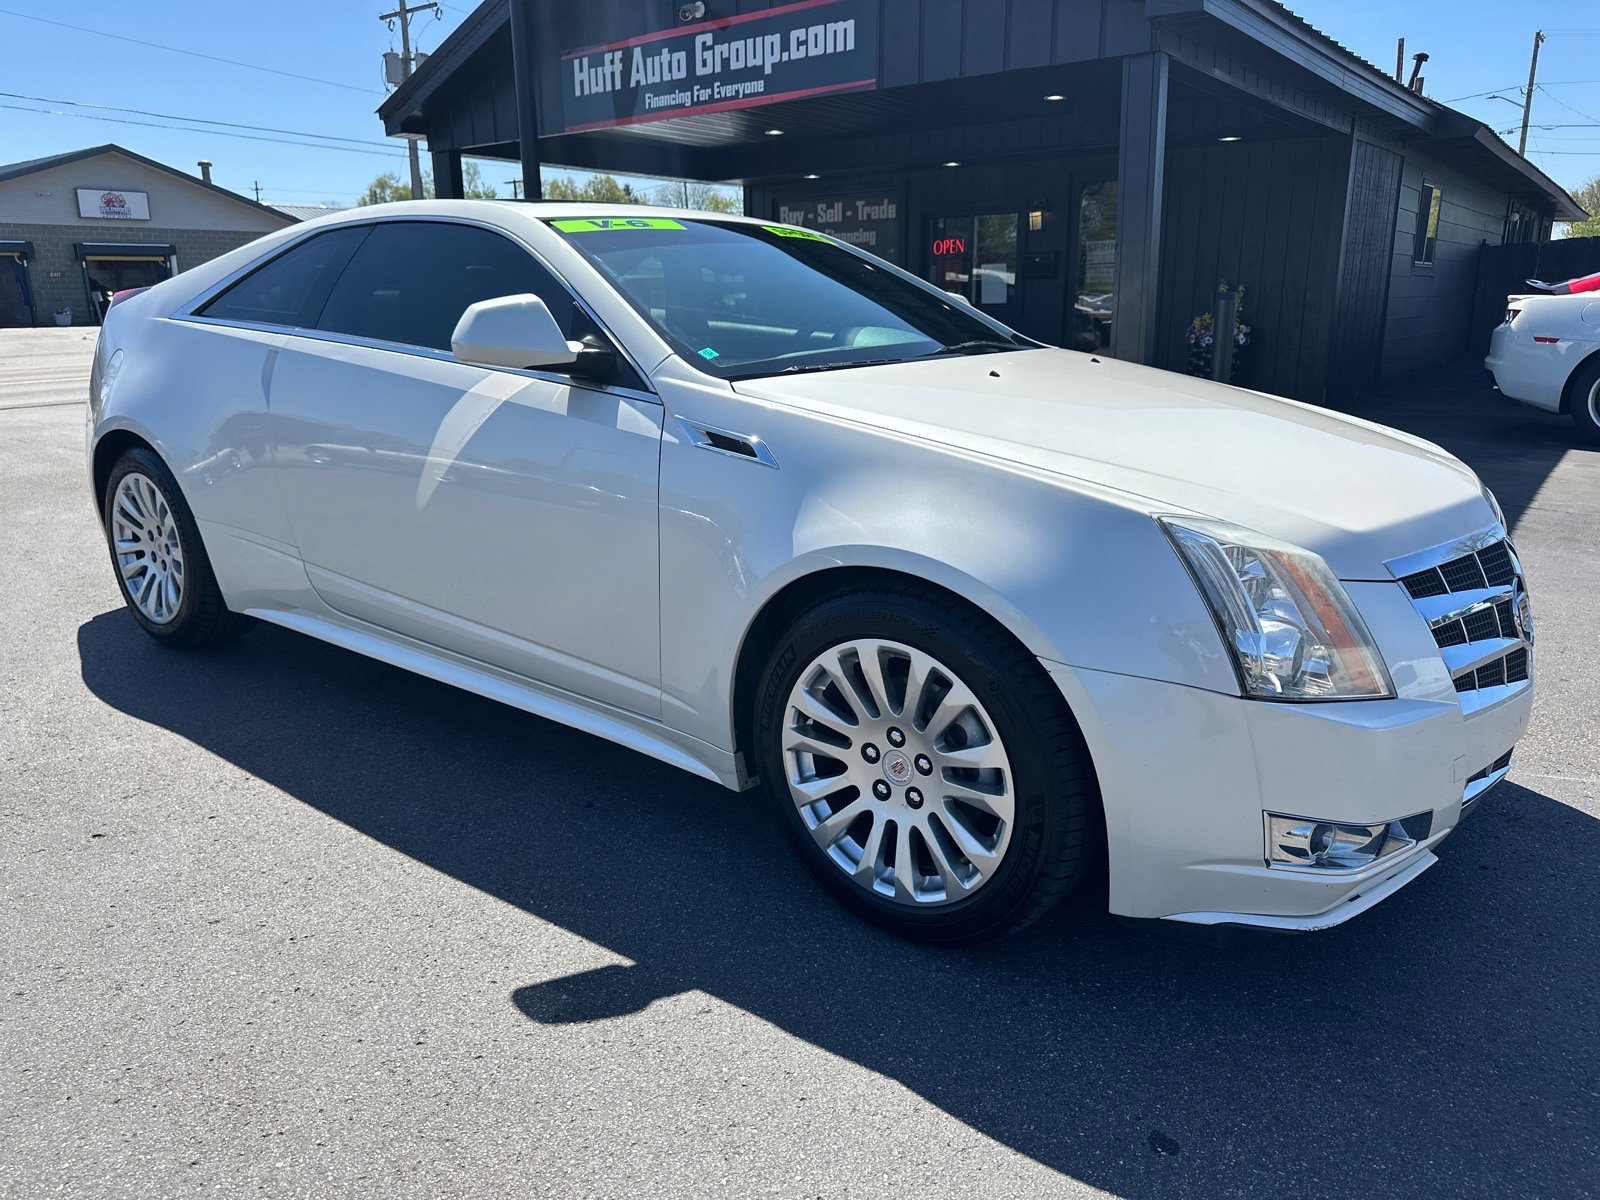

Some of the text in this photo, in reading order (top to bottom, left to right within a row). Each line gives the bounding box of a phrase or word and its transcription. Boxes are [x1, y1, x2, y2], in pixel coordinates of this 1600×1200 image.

[573, 18, 856, 97] Huff Auto Group.com
[645, 79, 765, 110] Financing For Everyone
[779, 206, 805, 226] Buy
[817, 202, 843, 224] Sell
[856, 198, 897, 221] Trade
[933, 239, 966, 256] OPEN
